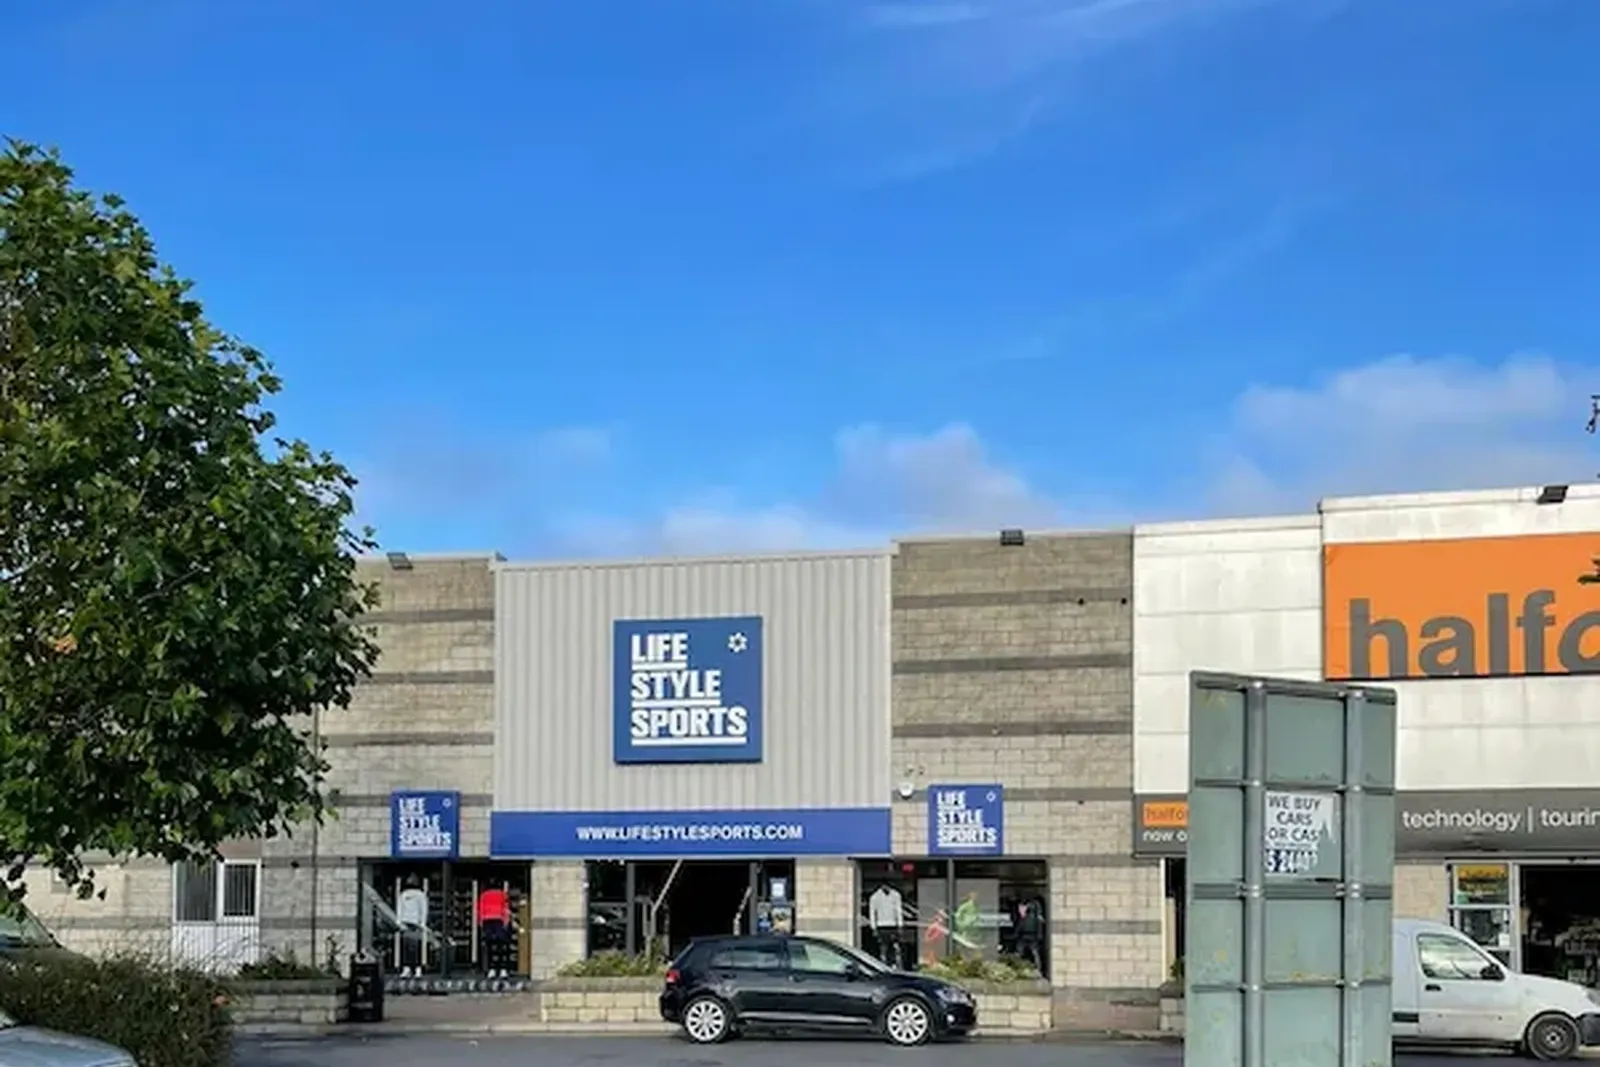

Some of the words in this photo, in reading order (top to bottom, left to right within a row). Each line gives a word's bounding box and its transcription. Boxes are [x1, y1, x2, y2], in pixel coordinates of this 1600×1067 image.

[631, 633, 688, 661] LIFE
[631, 670, 721, 699] STYLE
[631, 706, 748, 737] SPORTS
[400, 798, 426, 812] LIFE
[938, 791, 966, 805] LIFE
[1268, 796, 1290, 809] WE
[1294, 798, 1322, 811] BUY
[400, 815, 440, 829] STYLE
[938, 809, 984, 824] STYLE
[1276, 811, 1313, 826] CARS
[1402, 808, 1522, 832] technology
[399, 832, 452, 846] SPORTS
[576, 824, 804, 841] WWW.LIFESTYLESPORTS.COM
[937, 827, 997, 843] SPORTS
[1143, 831, 1176, 841] now
[1291, 828, 1323, 842] CAS
